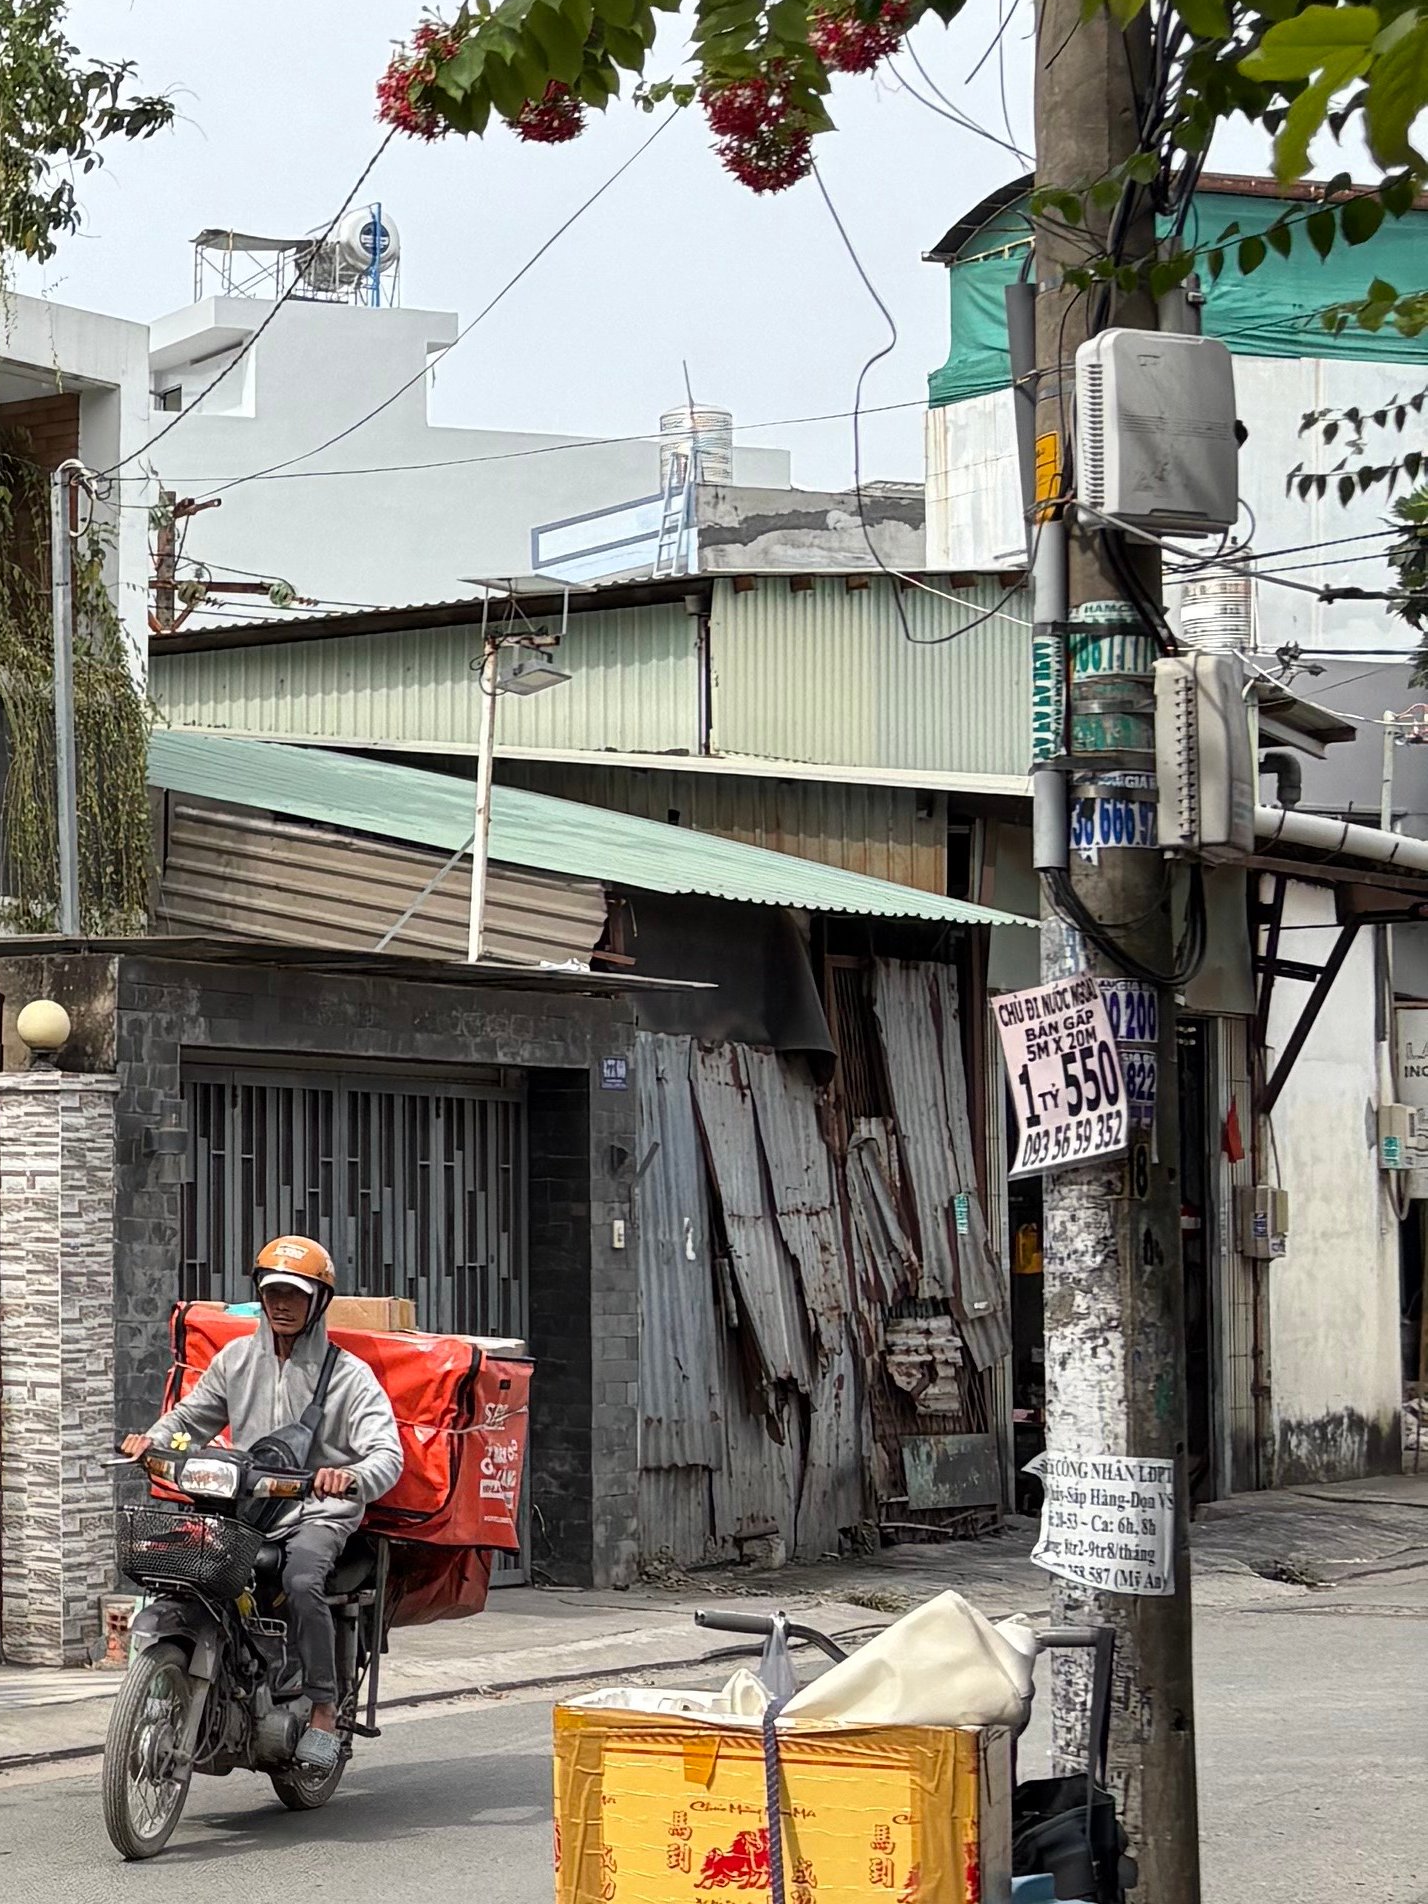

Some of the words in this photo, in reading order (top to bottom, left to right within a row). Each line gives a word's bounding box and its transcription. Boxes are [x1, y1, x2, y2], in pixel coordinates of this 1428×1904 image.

[999, 994, 1024, 1027] CHỦ
[1025, 997, 1041, 1021] ĐI
[1025, 1020, 1059, 1042] BÁN
[1026, 1040, 1050, 1062] 5M
[1053, 1036, 1064, 1055] X
[1066, 1025, 1097, 1050] 20M
[1018, 1063, 1041, 1129] 1
[1061, 1040, 1120, 1117] 550
[1022, 1129, 1050, 1167] 093
[1051, 1123, 1071, 1160] 56
[1073, 1117, 1092, 1155] 59
[1095, 1109, 1122, 1150] 352
[1091, 1459, 1135, 1482] NHÂN
